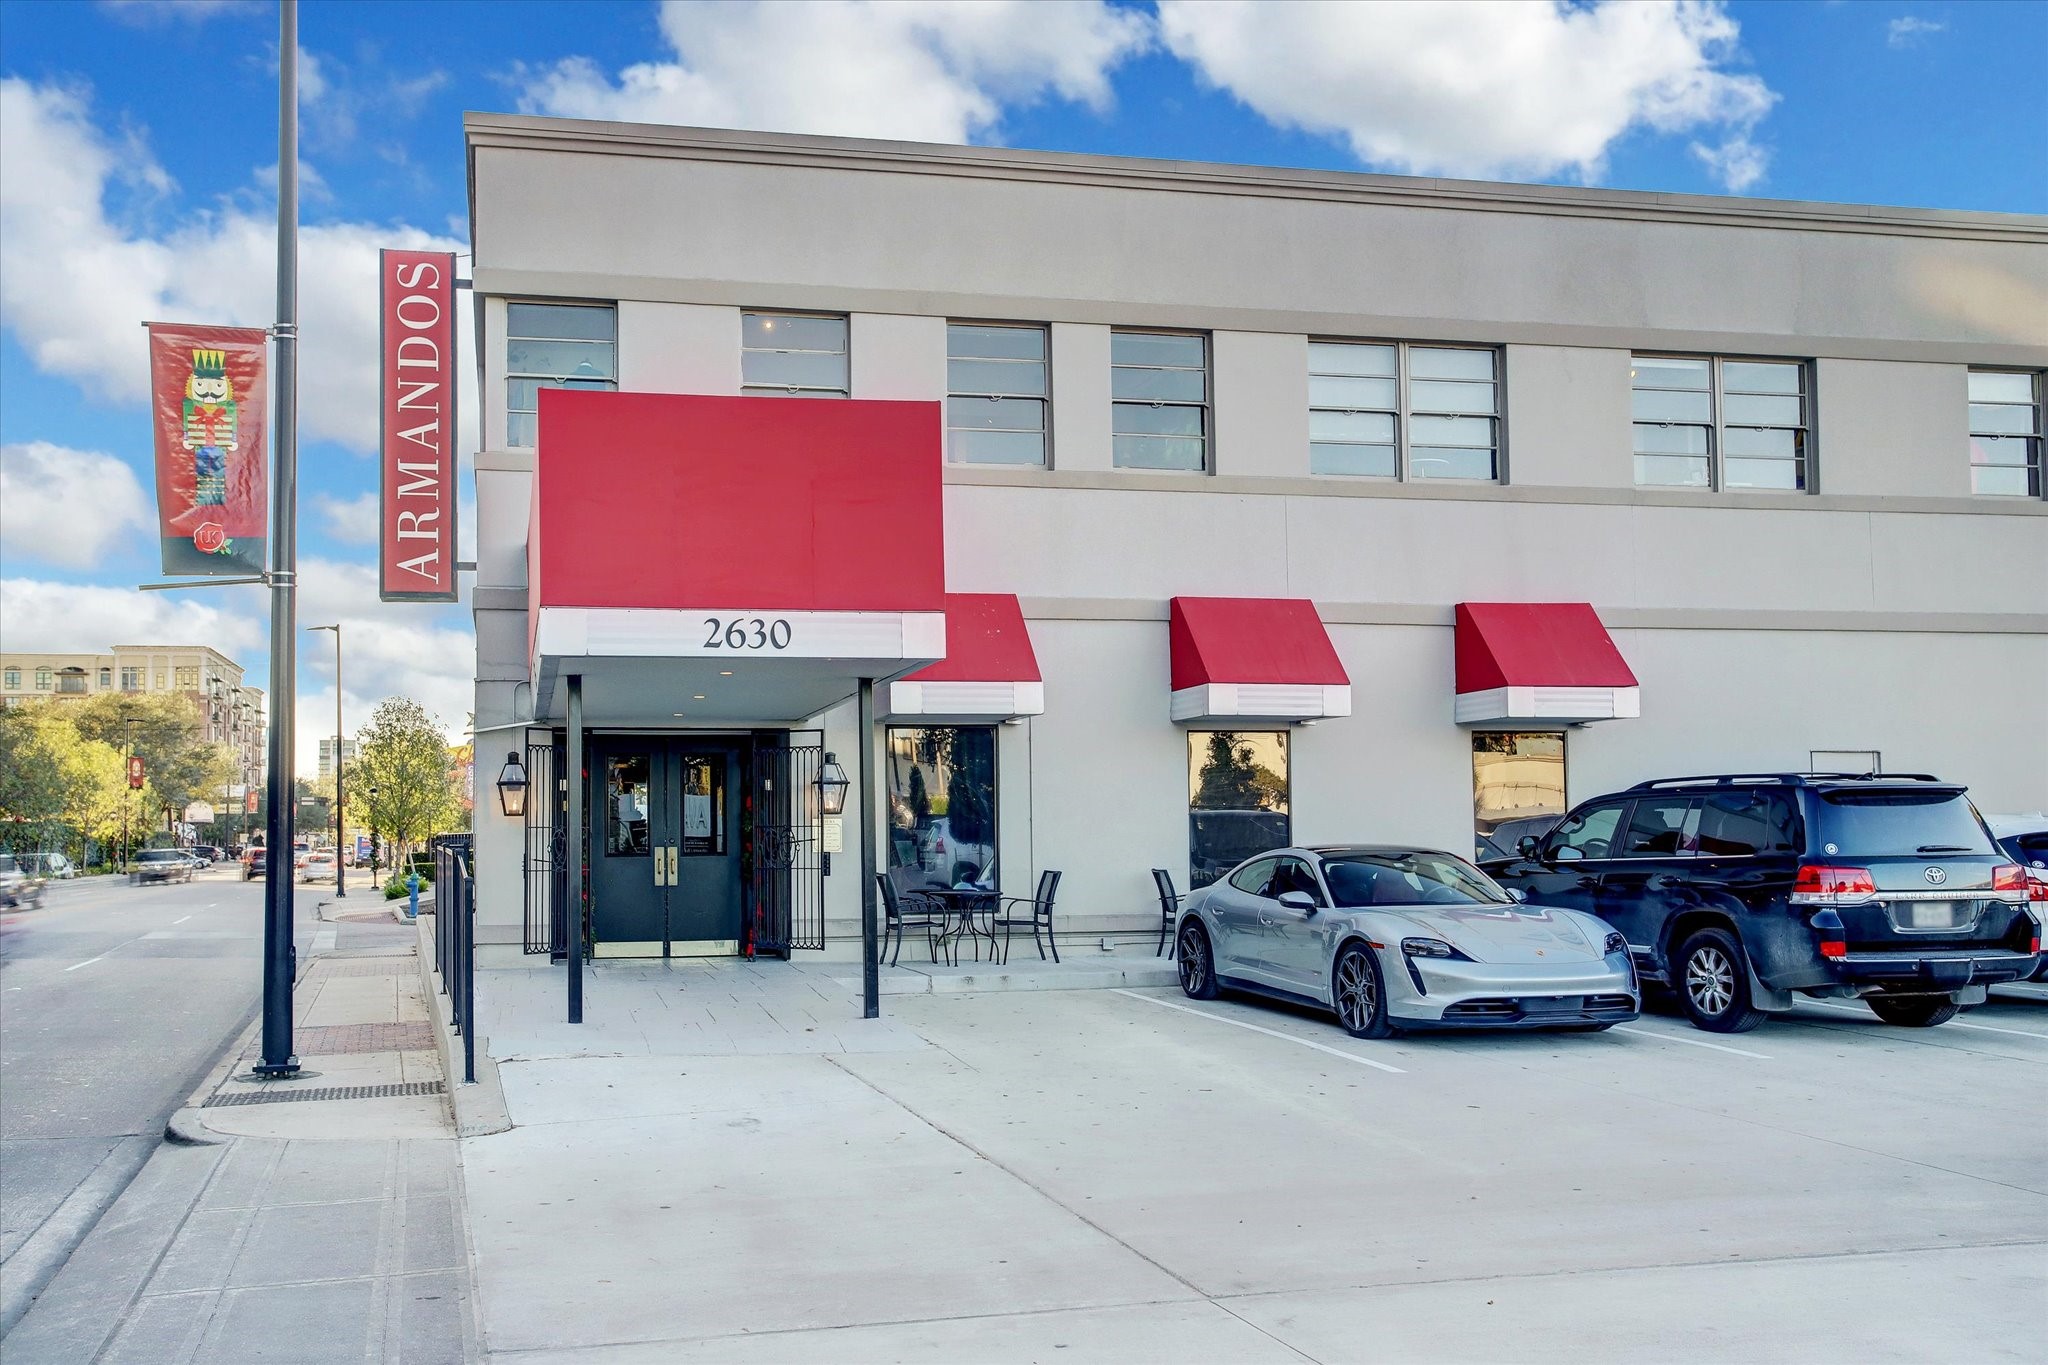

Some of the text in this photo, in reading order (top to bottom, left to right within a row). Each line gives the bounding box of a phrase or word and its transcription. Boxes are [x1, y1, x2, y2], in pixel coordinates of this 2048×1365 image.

[396, 262, 440, 585] ARMANDOS
[199, 530, 220, 544] UK
[703, 617, 792, 650] 2630
